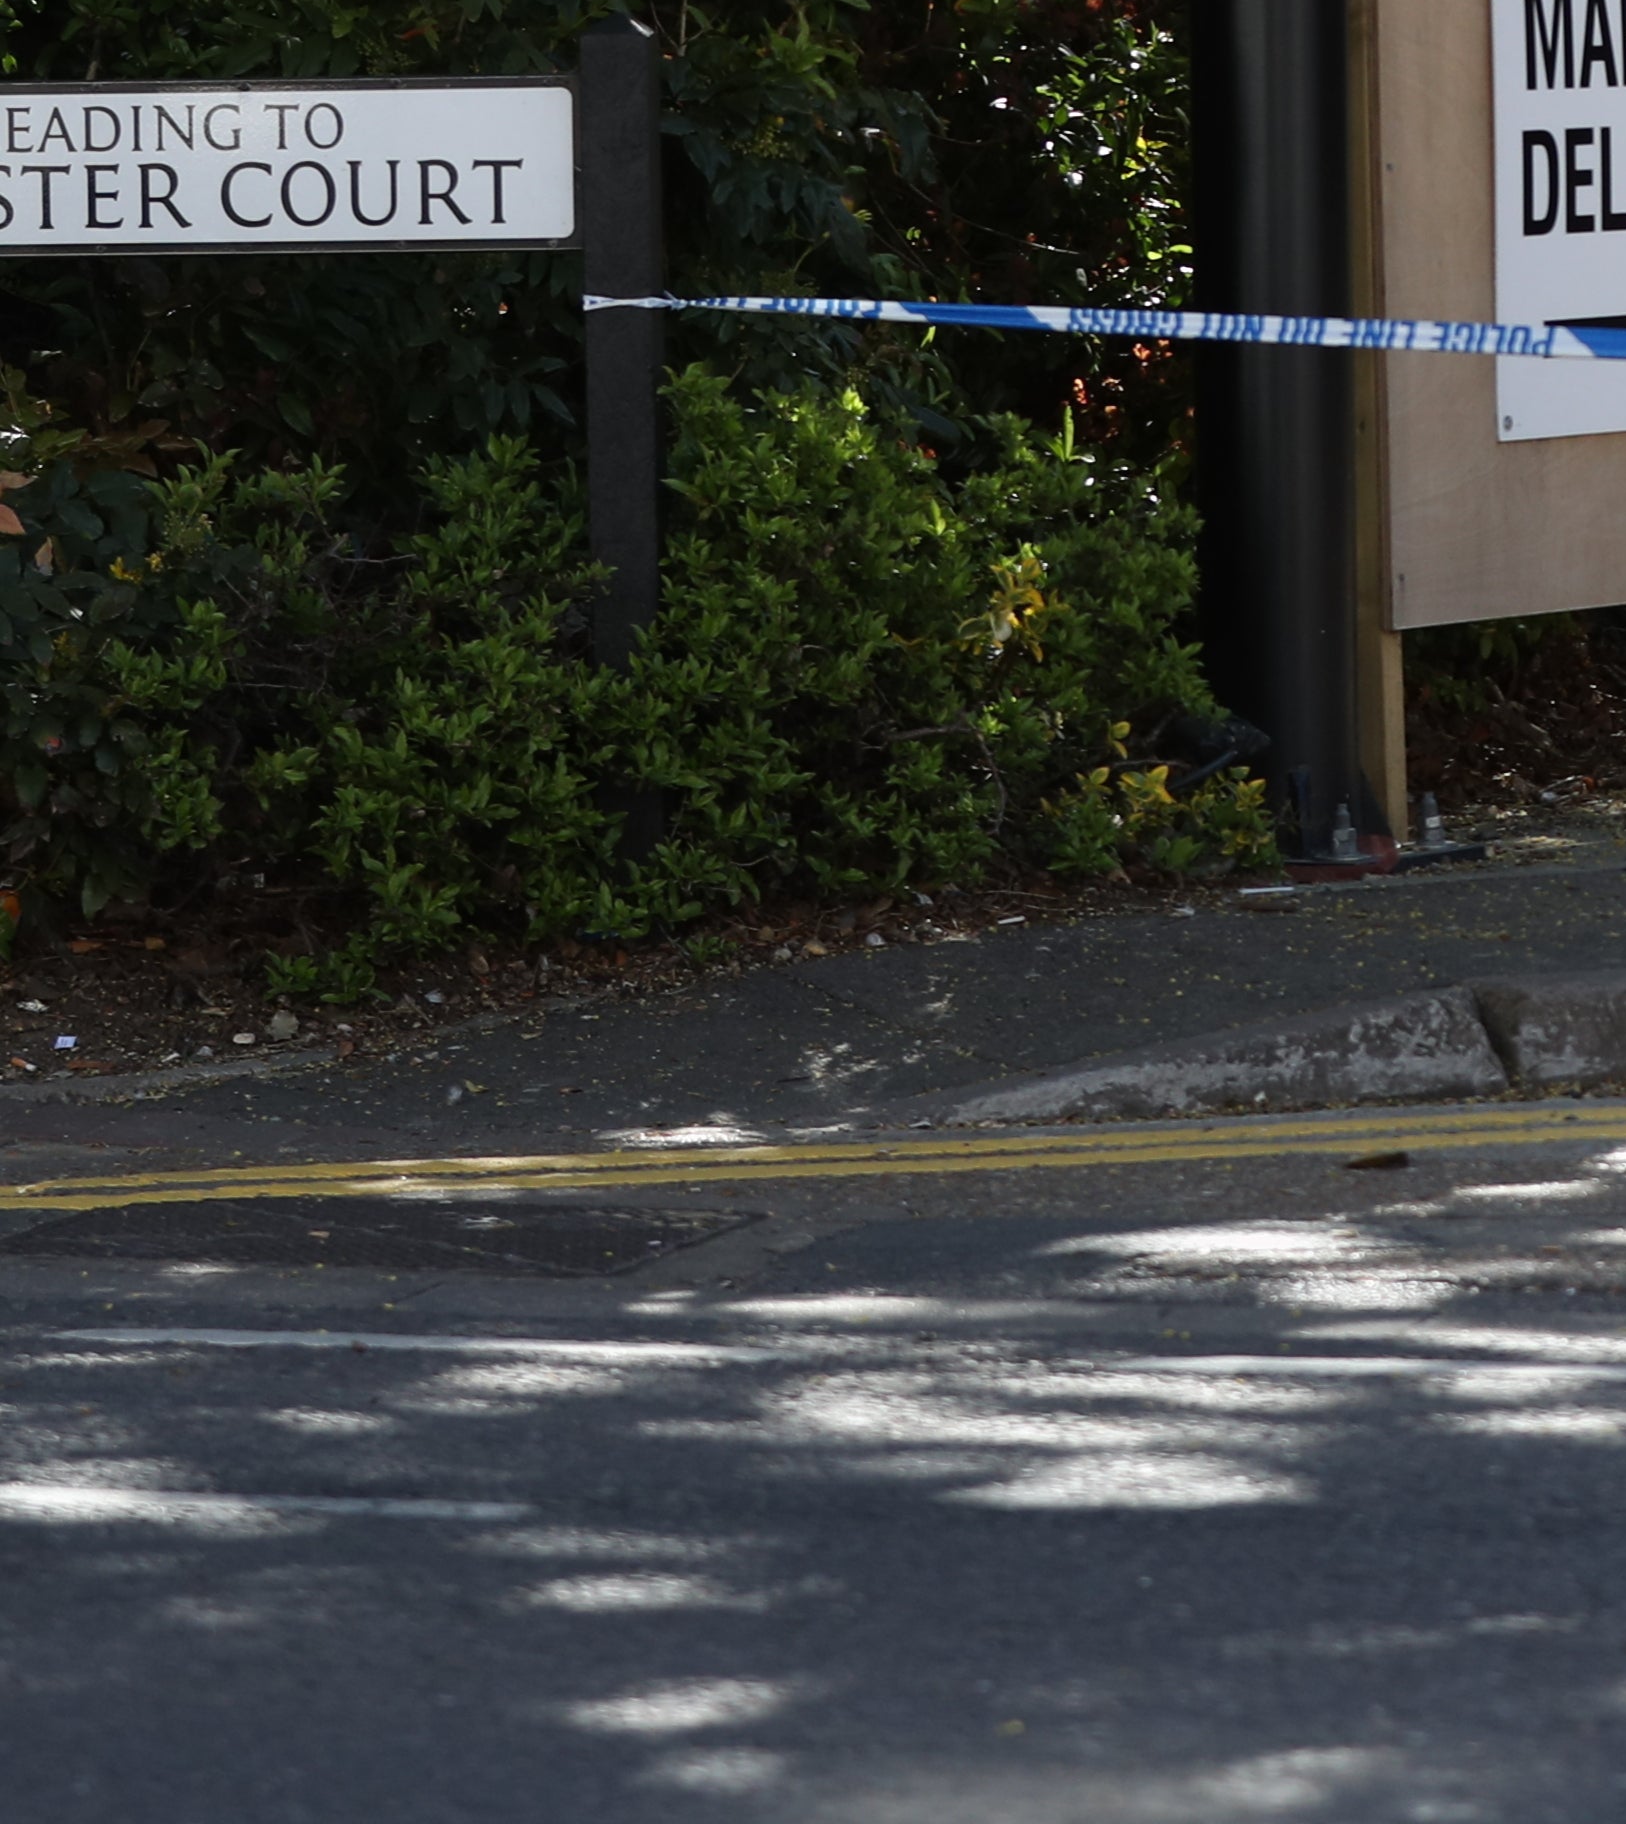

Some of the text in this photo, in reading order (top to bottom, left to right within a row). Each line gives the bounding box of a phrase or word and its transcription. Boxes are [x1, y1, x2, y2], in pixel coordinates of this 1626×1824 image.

[264, 102, 345, 150] TO
[220, 157, 525, 228] COURT
[1342, 317, 1417, 349] LINE
[1431, 320, 1556, 356] POLICE
